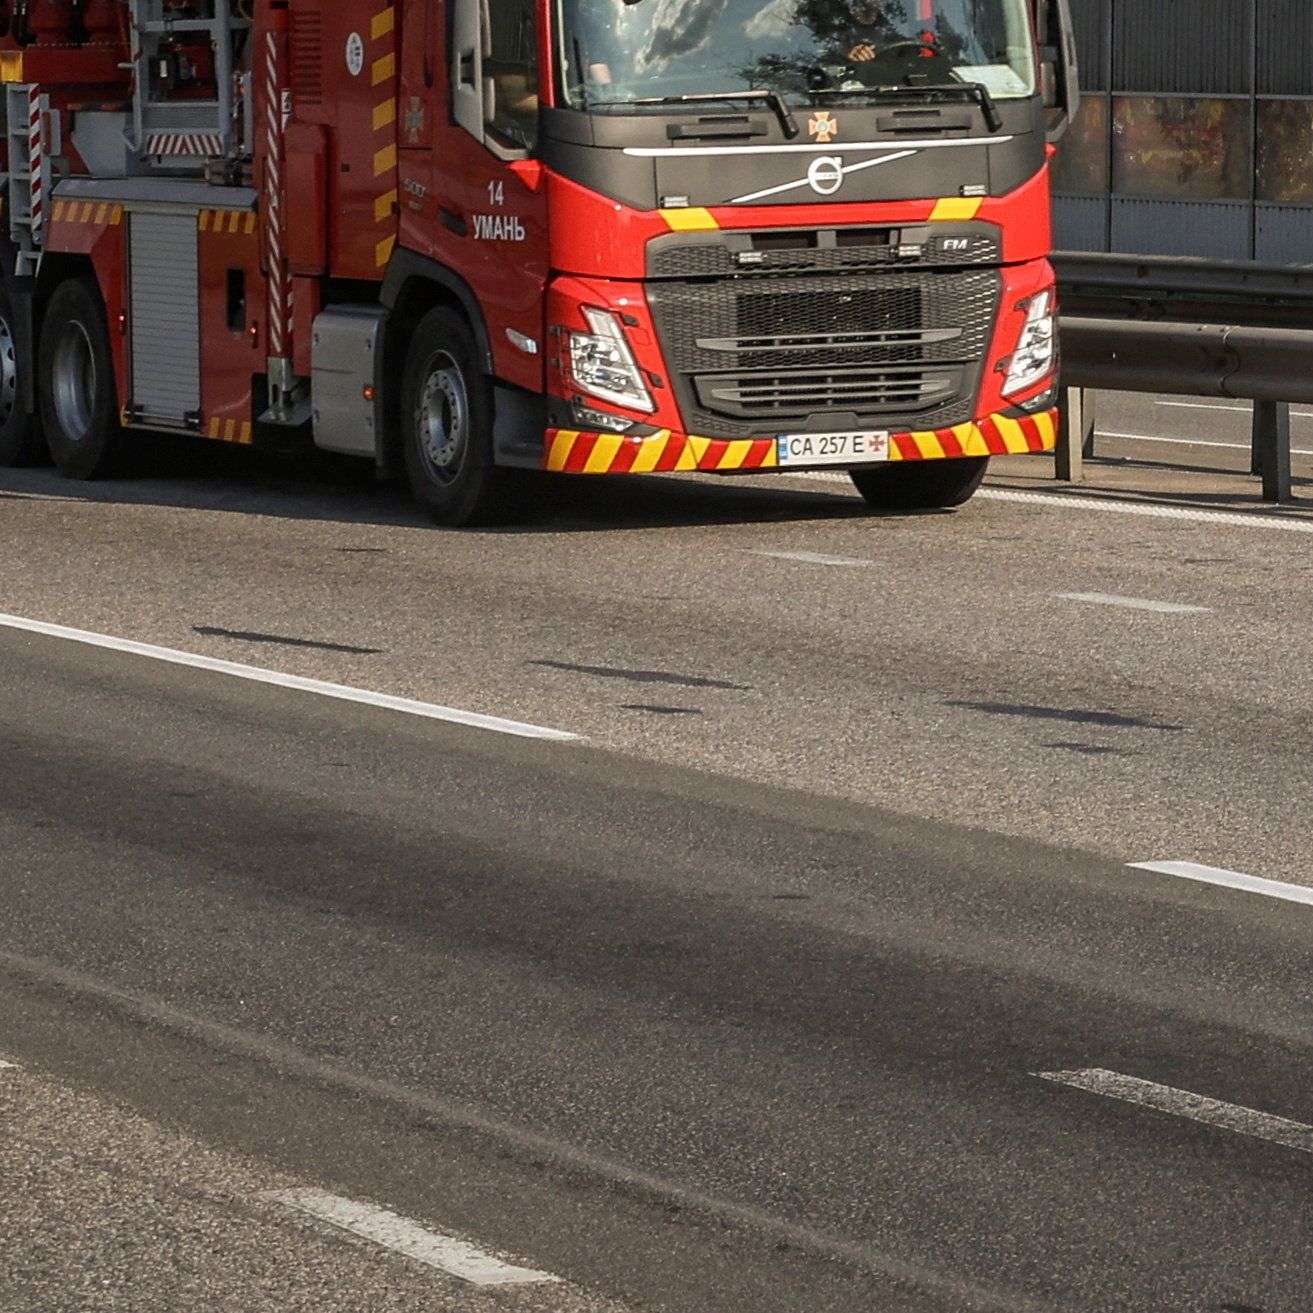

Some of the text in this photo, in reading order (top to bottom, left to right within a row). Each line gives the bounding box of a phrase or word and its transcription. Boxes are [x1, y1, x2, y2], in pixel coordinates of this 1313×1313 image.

[487, 180, 504, 206] 14
[472, 214, 526, 241] УМАНЬ
[943, 238, 968, 251] FM
[789, 435, 865, 456] CA 257 E
